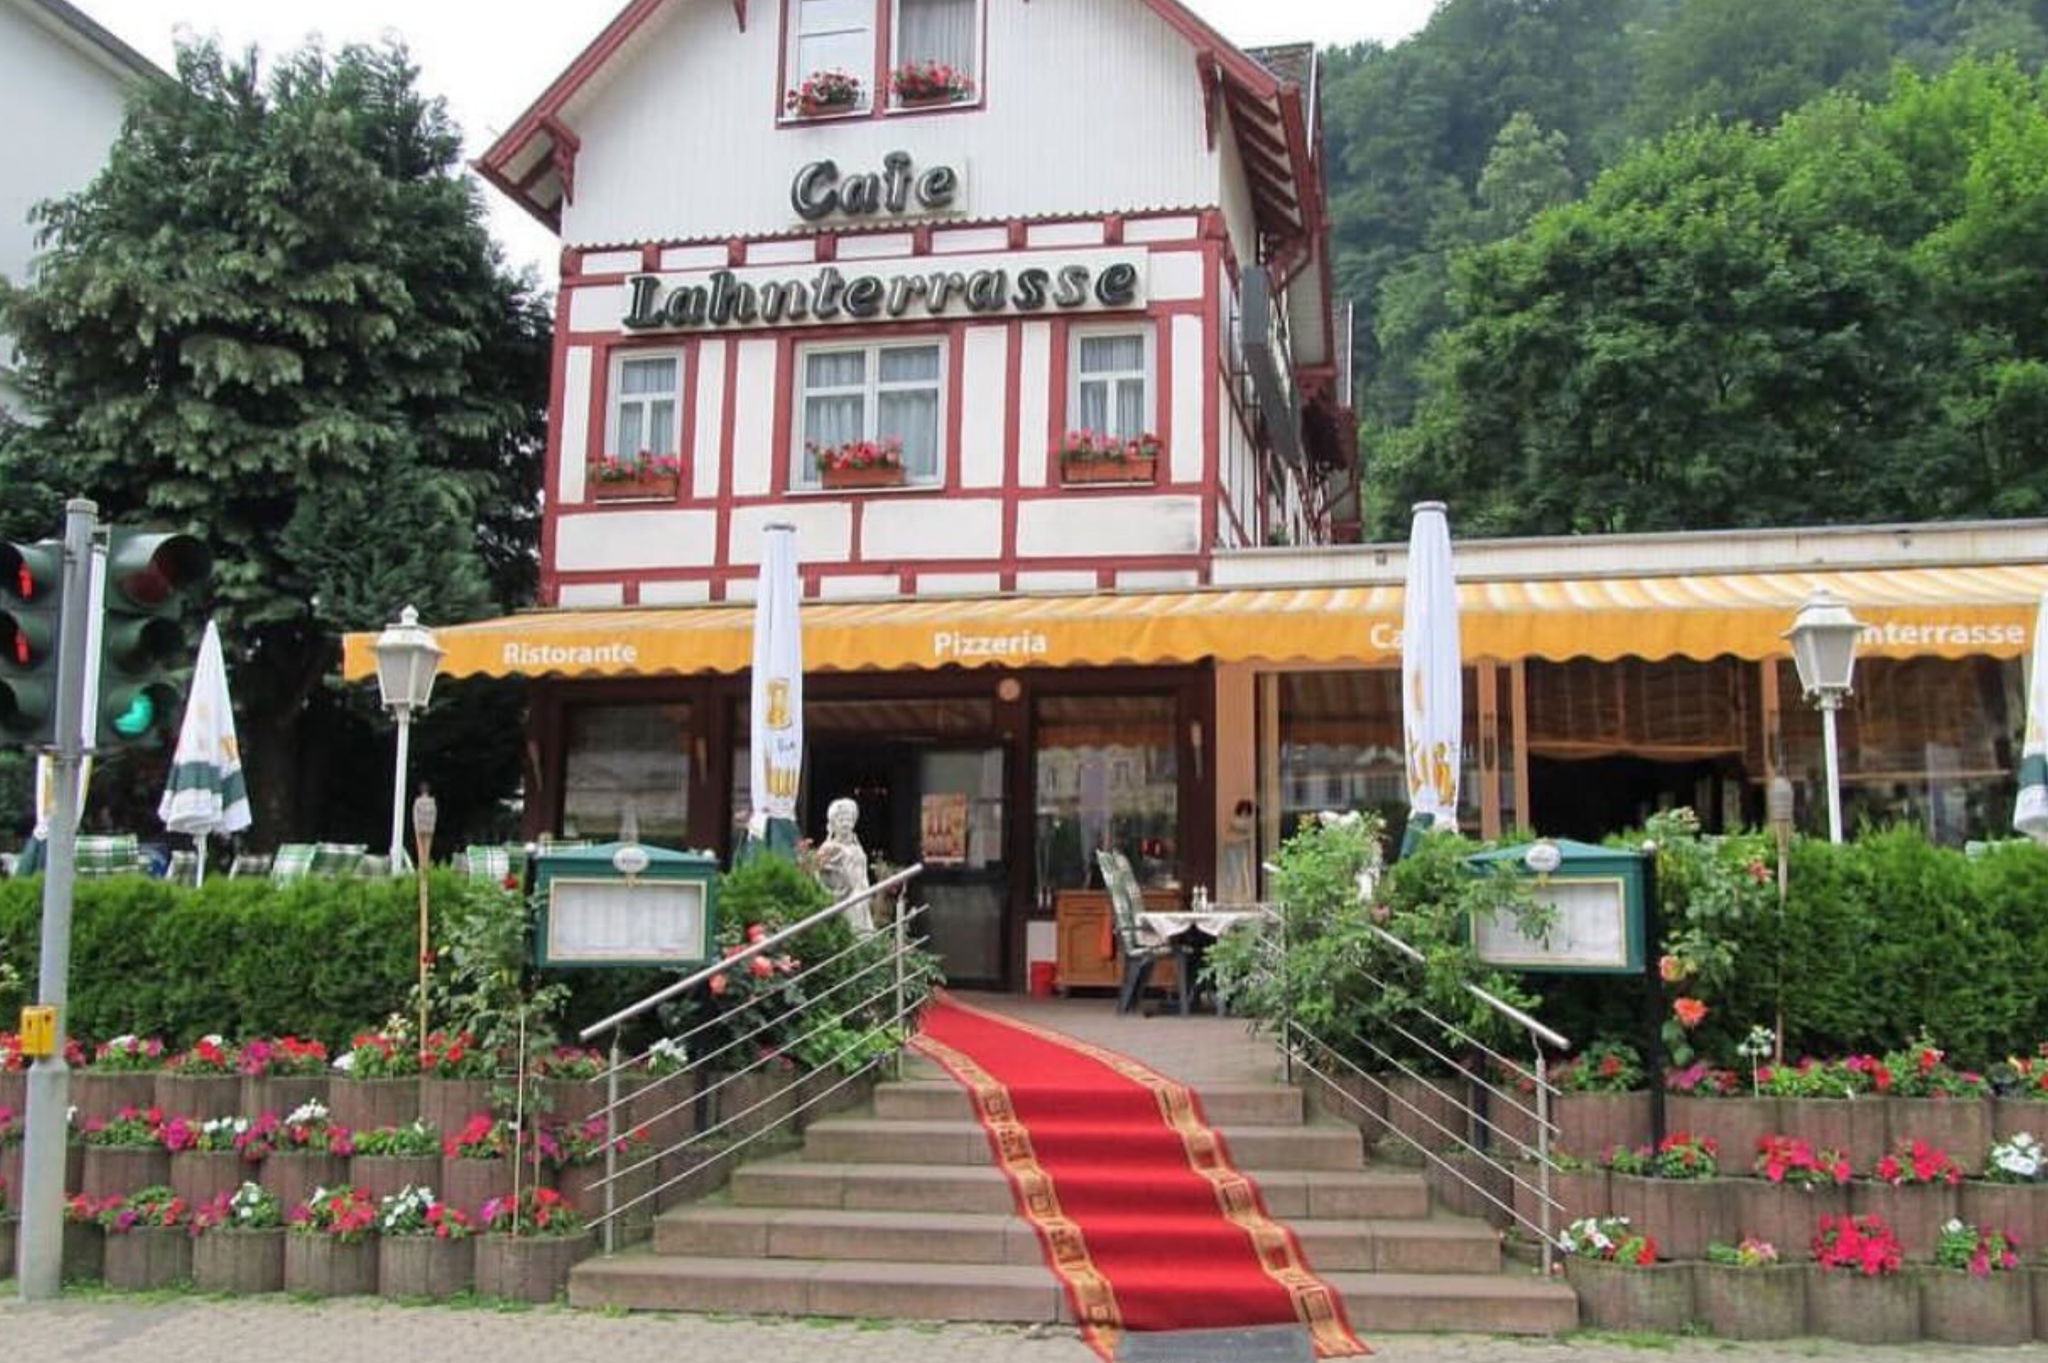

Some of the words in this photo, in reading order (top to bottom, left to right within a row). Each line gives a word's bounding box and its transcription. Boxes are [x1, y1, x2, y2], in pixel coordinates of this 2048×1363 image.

[791, 151, 958, 221] Cafe
[623, 262, 1138, 329] Lahnterrasse
[934, 630, 1047, 657] Pizzeria
[1857, 621, 2025, 645] nterrasse
[503, 641, 638, 665] Ristorante
